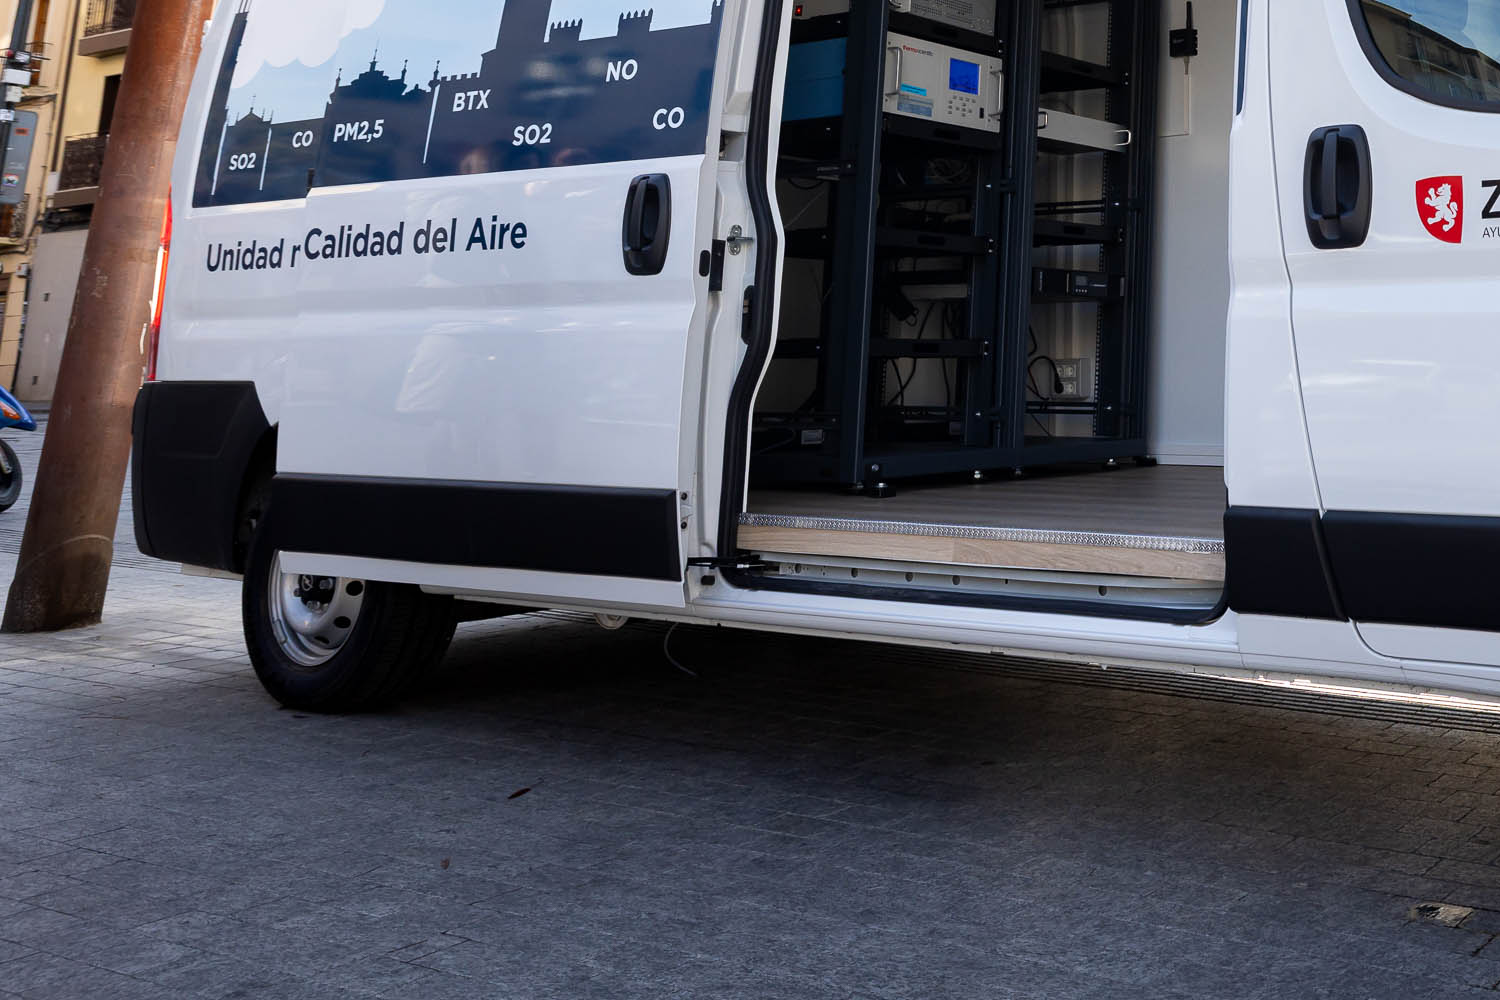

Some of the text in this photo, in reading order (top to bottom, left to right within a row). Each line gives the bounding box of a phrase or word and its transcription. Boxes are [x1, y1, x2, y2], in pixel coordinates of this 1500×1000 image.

[606, 59, 637, 83] NO
[452, 88, 491, 113] BTX
[652, 106, 685, 130] CO
[291, 130, 314, 148] CO
[333, 119, 385, 143] PM2,5
[512, 122, 553, 146] SO2
[228, 152, 256, 171] SO2
[304, 215, 528, 260] Calidad del Aire
[206, 238, 285, 272] Unidad
